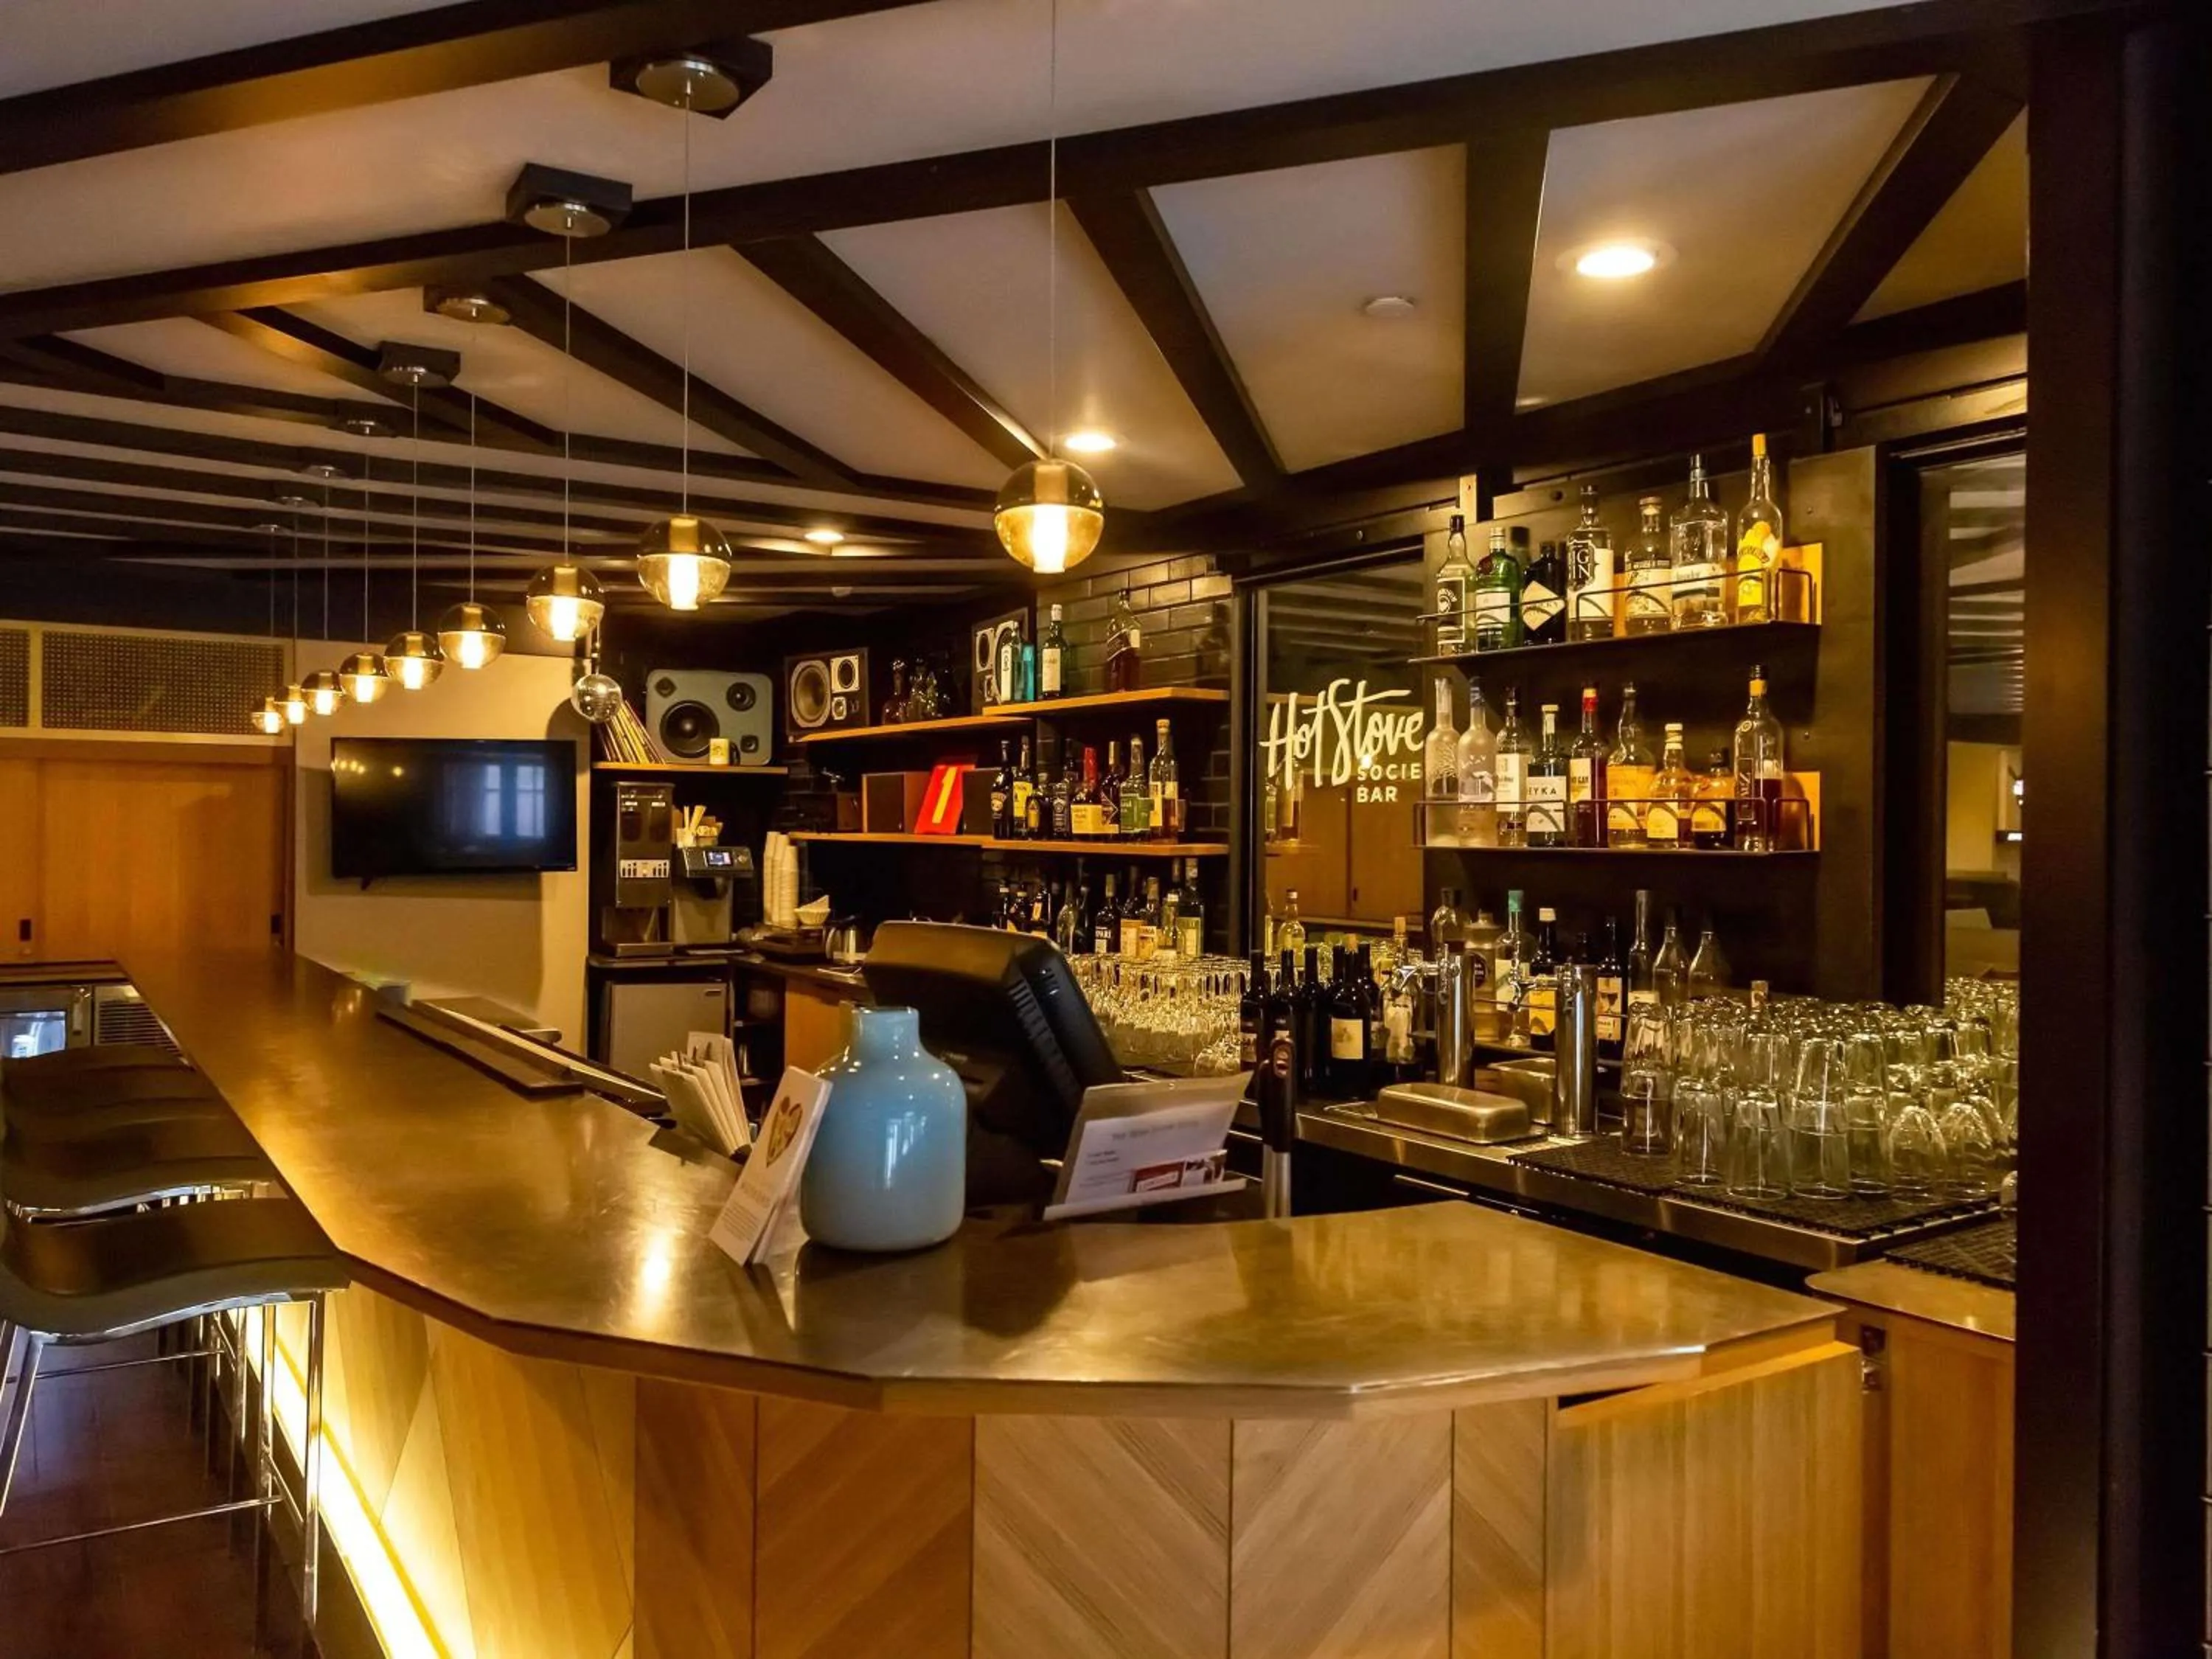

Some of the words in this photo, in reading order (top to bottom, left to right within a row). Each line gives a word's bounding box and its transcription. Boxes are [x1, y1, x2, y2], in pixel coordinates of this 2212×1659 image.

[1259, 691, 1328, 790] Hot
[1328, 678, 1424, 786] Stove
[1357, 763, 1422, 781] SOCIE
[1357, 786, 1398, 803] BAR
